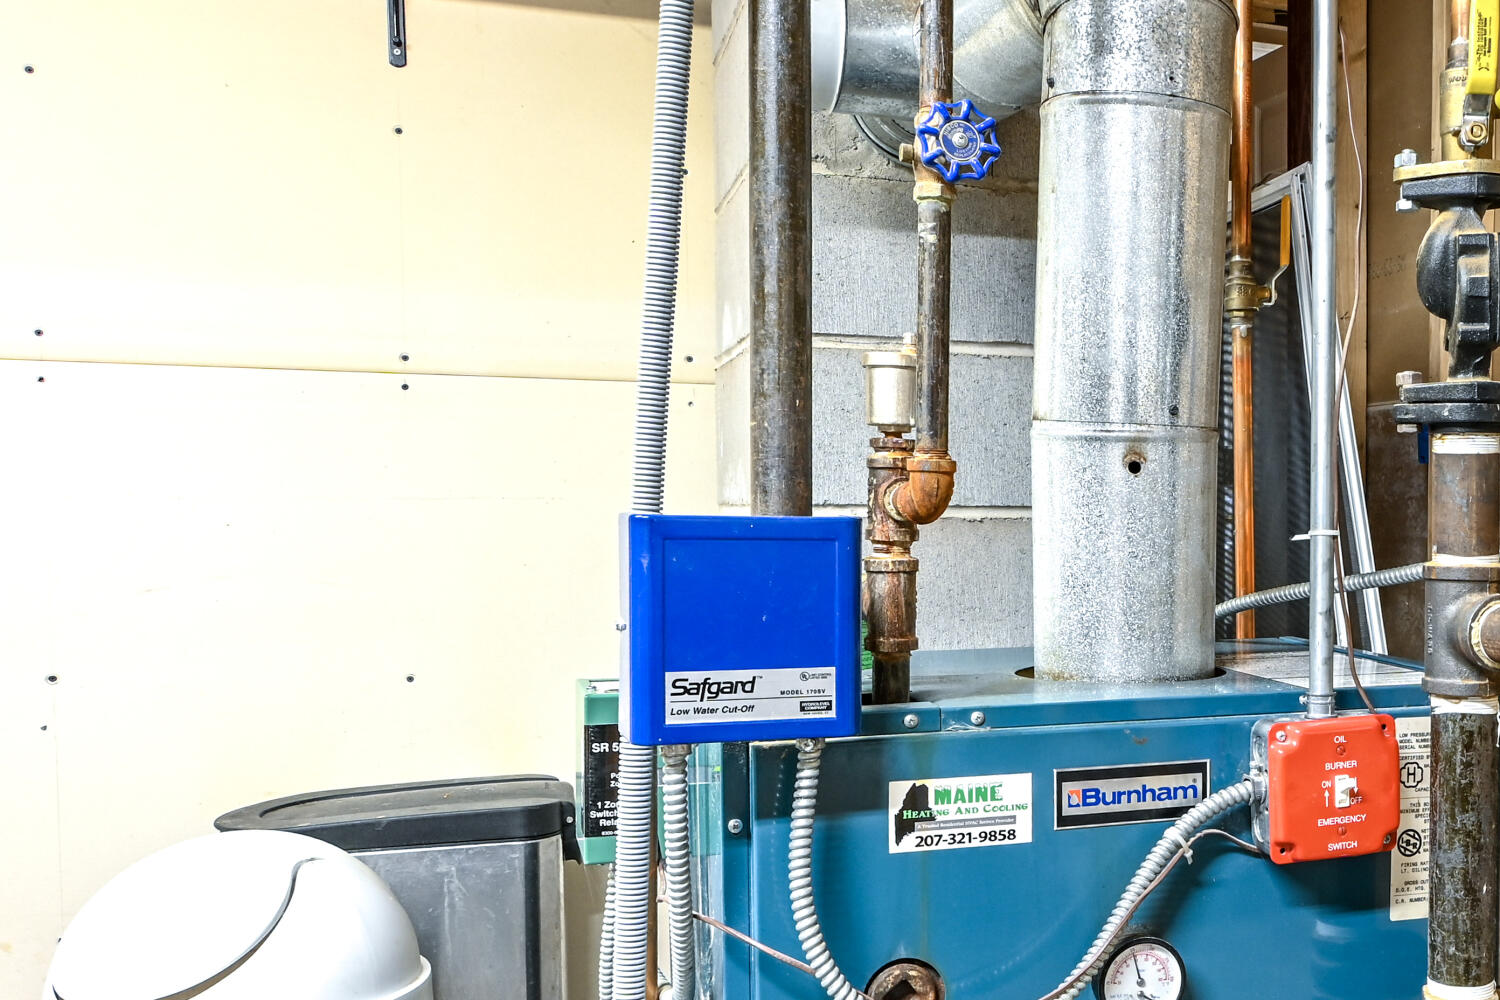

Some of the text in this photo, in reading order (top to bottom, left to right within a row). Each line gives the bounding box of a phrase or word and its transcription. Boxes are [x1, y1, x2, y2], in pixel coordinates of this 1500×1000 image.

[671, 705, 754, 716] Low Water Cut-Off
[1334, 735, 1347, 743] OIL
[591, 742, 620, 753] SR 5
[1325, 761, 1358, 770] BURNER
[934, 781, 1004, 805] MAINE
[1080, 784, 1198, 807] Burnham
[597, 801, 601, 809] 1
[590, 810, 618, 818] Switch
[1317, 814, 1366, 827] EMERGENCY
[915, 829, 1016, 847] 207-321-9858
[1328, 841, 1357, 851] SWITCH
